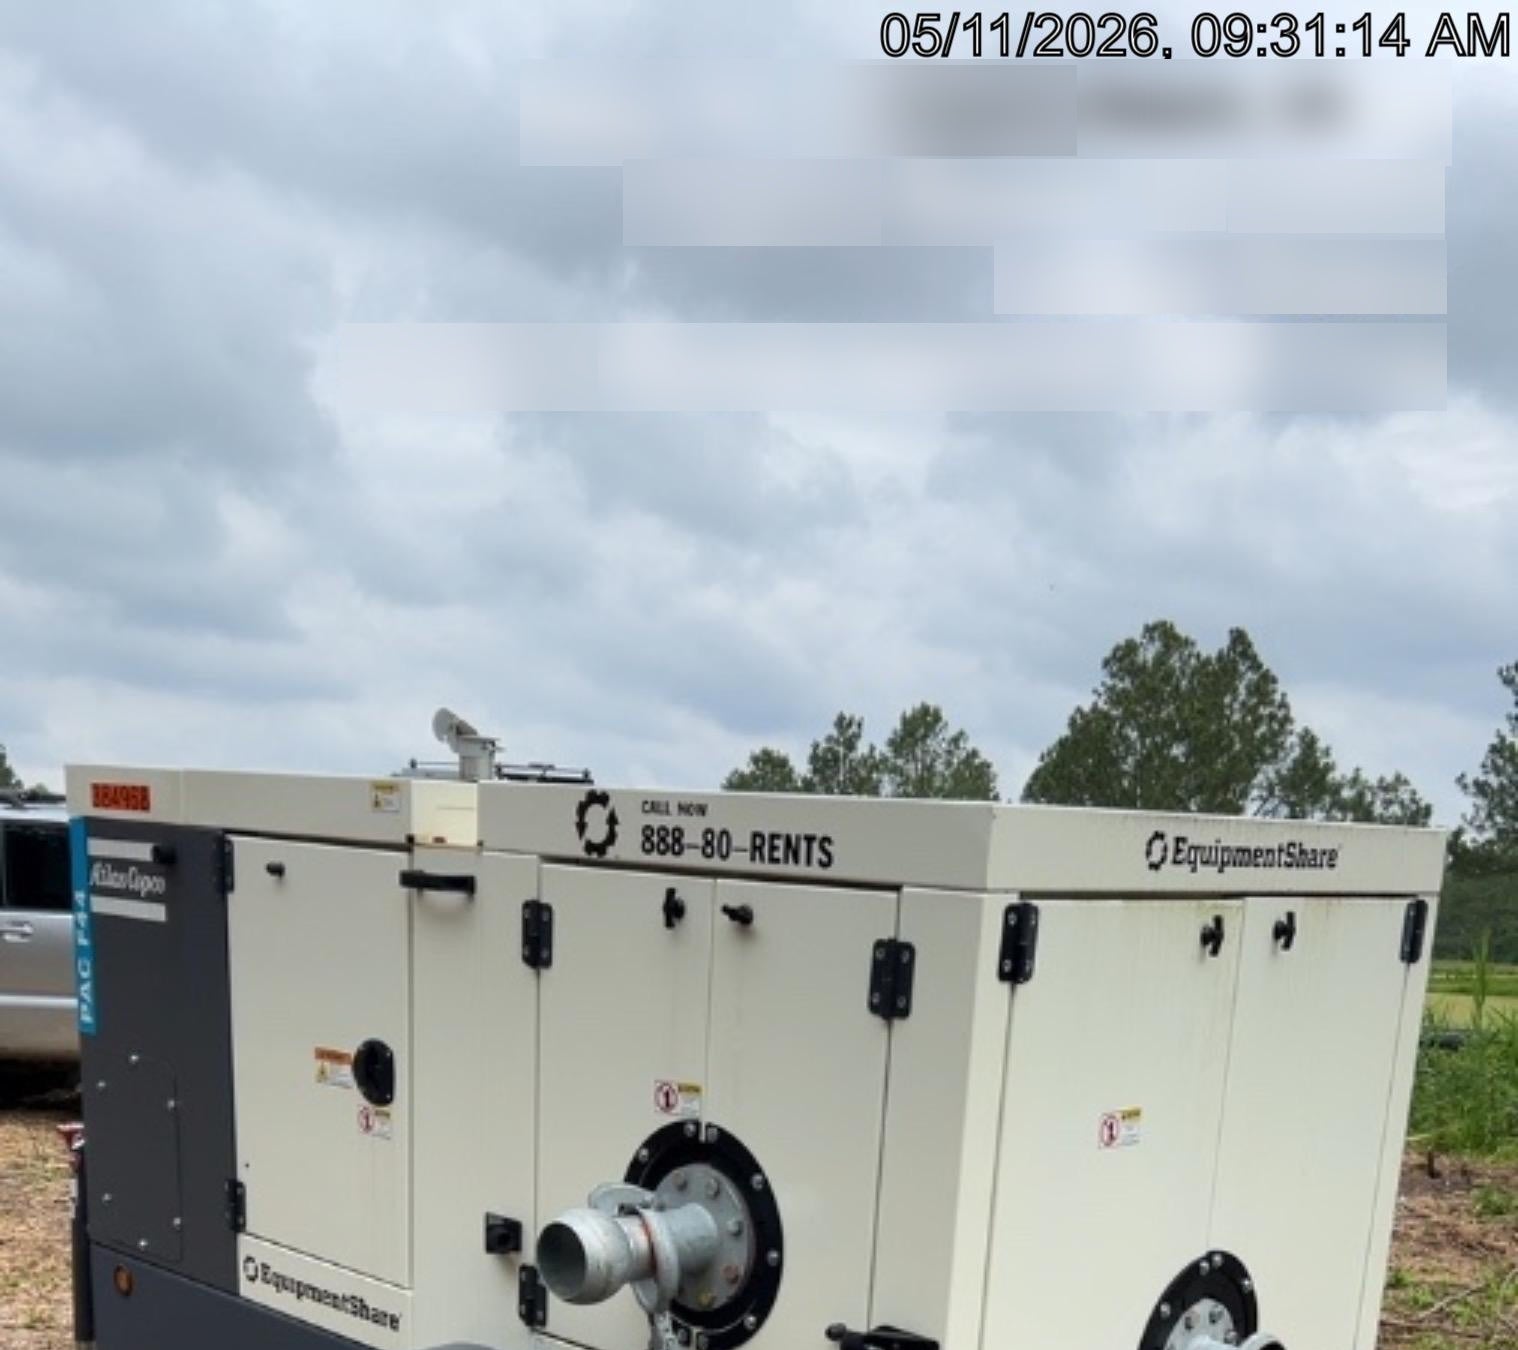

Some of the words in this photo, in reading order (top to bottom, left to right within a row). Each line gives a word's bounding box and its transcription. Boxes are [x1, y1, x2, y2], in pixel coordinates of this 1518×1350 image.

[641, 799, 671, 816] CALL
[677, 802, 709, 817] NOW
[640, 824, 834, 868] 888-80-RENTS
[1171, 836, 1339, 873] EquipmentShare
[78, 959, 94, 1024] PAC
[259, 1262, 400, 1332] EquipmentShare
